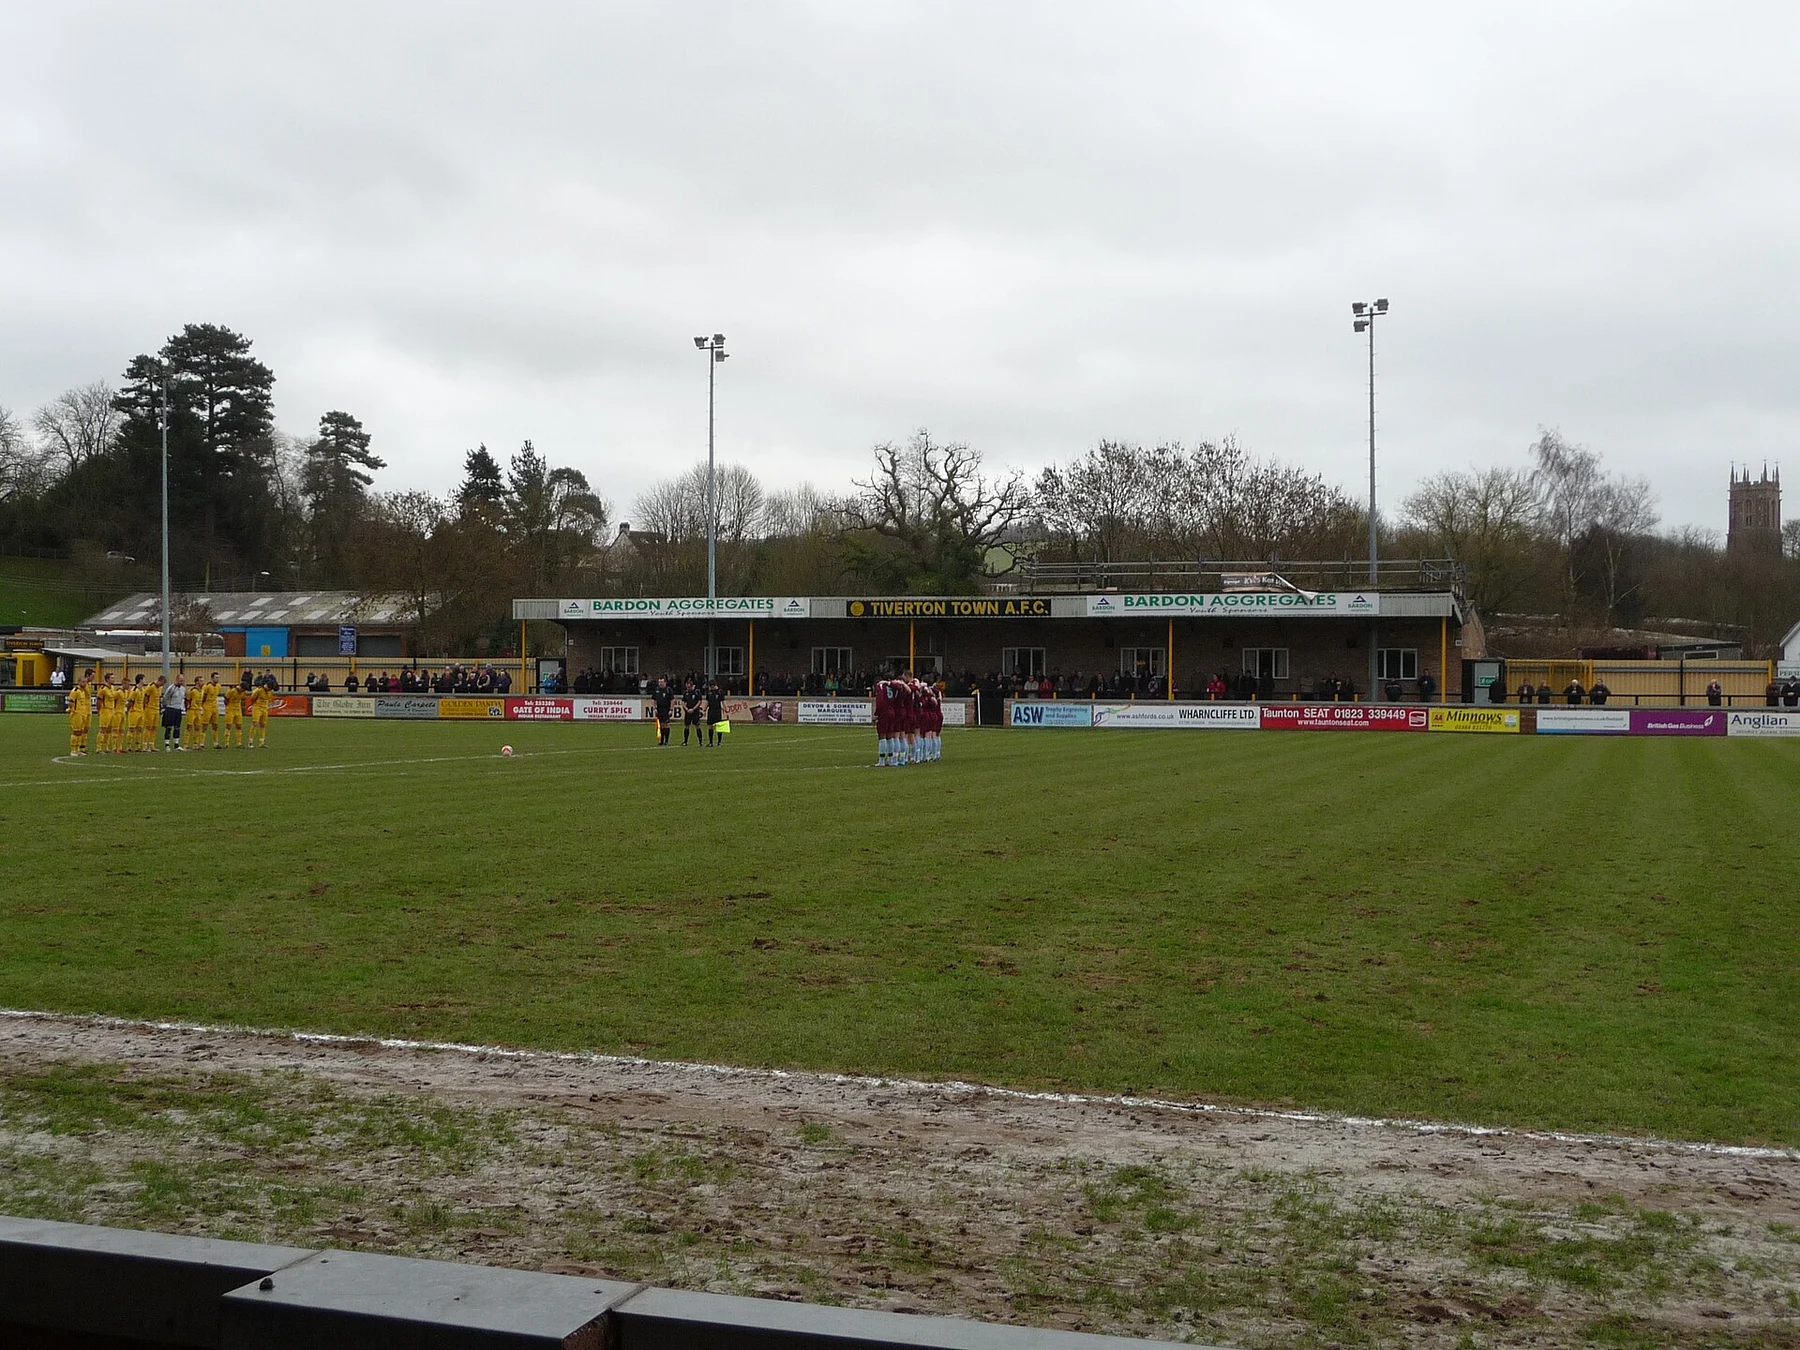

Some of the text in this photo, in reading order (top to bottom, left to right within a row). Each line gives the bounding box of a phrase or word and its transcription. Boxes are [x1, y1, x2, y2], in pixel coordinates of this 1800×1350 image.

[593, 599, 774, 611] BARDON AGGREGATES
[1124, 596, 1204, 607] BARDON
[871, 601, 1049, 615] TIVERTON TOWN A.F.C.
[317, 699, 330, 708] The
[333, 699, 353, 708] Globe
[513, 706, 570, 714] GATE OF INDIA
[1013, 706, 1044, 724] ASW
[1179, 709, 1237, 719] WHARNCLIFFE
[1262, 708, 1406, 719] Taunton SEAT 01823 339449
[1446, 710, 1502, 722] Minnows
[1731, 714, 1788, 729] Anglian
[1298, 718, 1370, 726] www.tauntonseat.com
